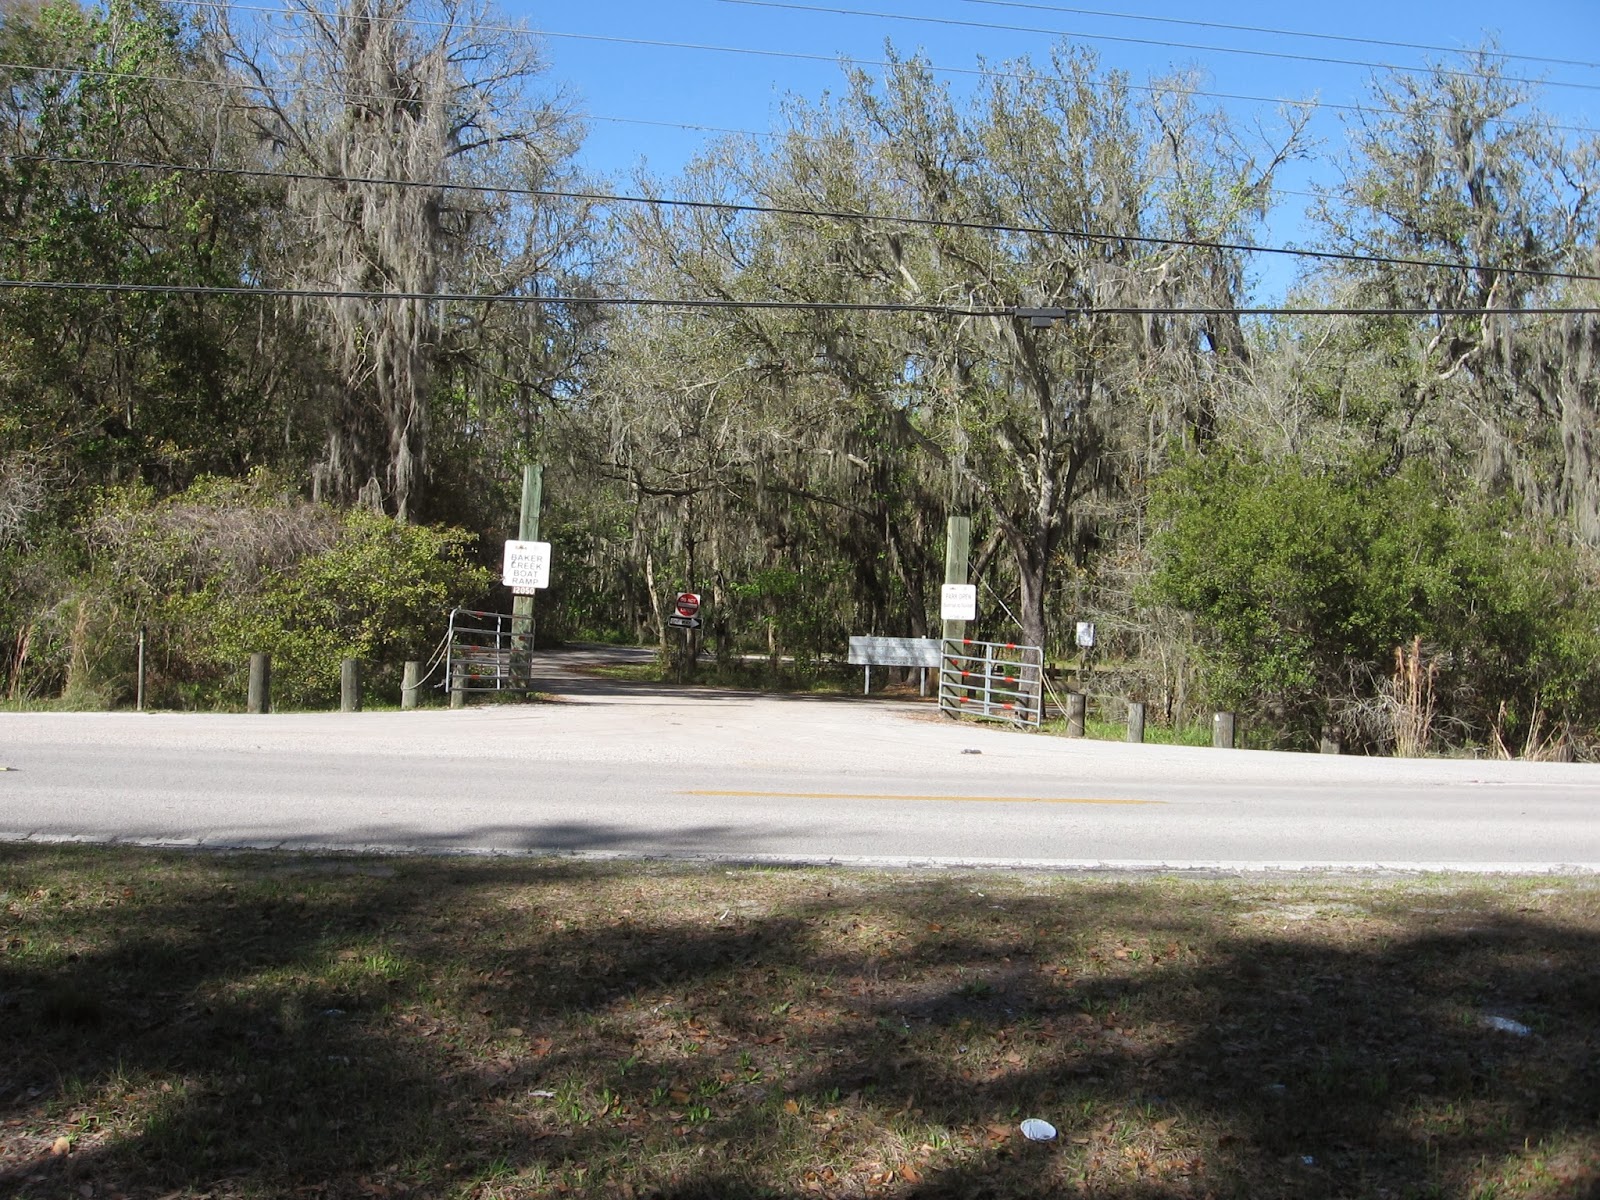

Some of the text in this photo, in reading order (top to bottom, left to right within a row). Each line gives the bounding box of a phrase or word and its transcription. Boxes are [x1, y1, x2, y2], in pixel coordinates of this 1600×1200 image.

[511, 554, 543, 562] BAKER
[511, 561, 542, 570] CREEK
[513, 570, 538, 578] BOAT
[513, 586, 535, 595] 12050
